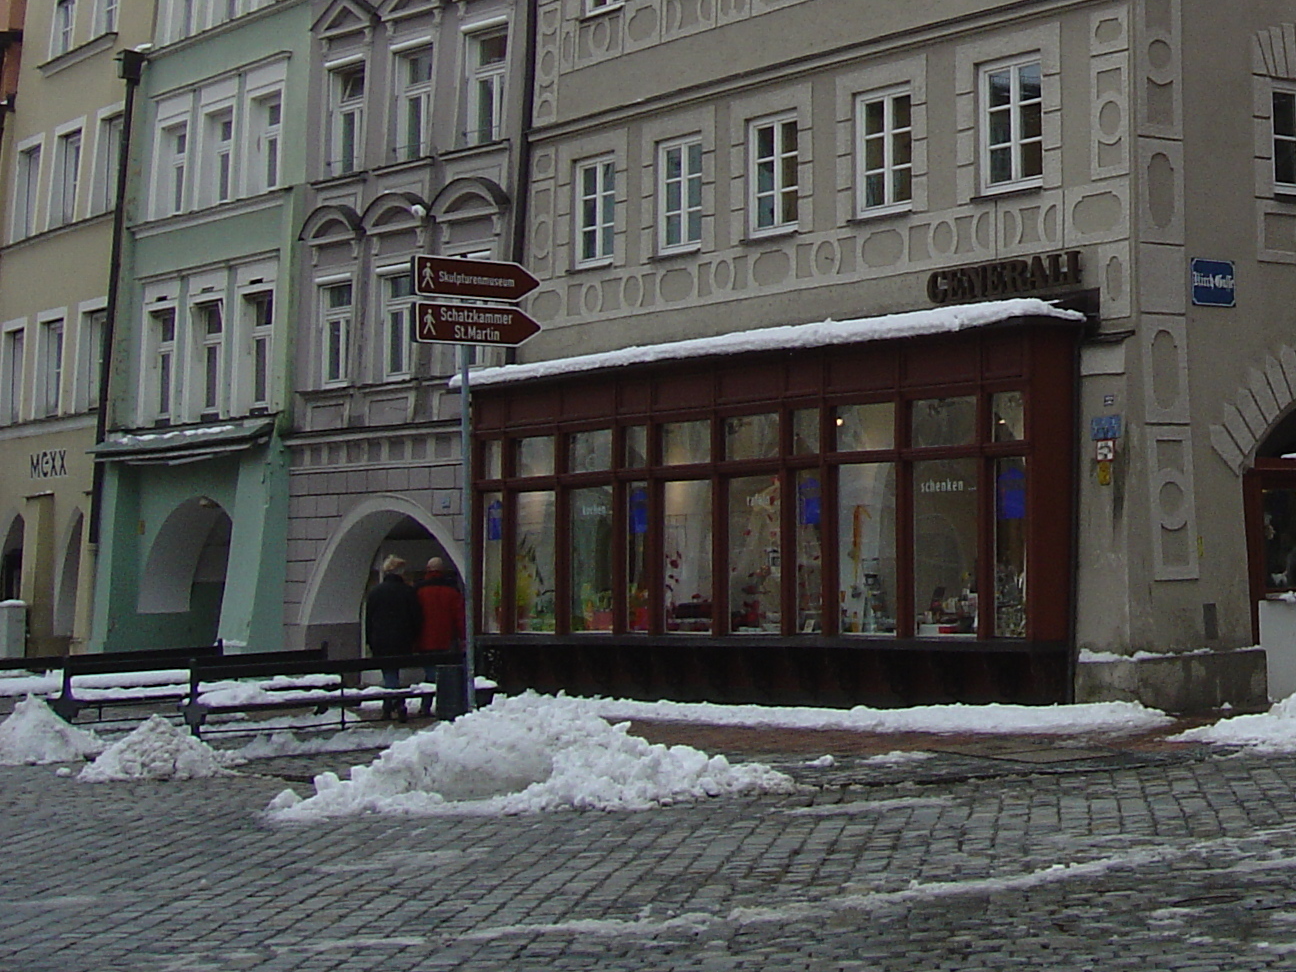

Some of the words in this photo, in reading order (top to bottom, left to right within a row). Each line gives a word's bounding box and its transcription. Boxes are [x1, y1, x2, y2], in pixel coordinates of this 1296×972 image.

[438, 270, 515, 287] Skulpturenmuseum
[926, 250, 1083, 303] GENERALI
[440, 307, 513, 325] Schatzkammer
[921, 478, 963, 493] schenken
